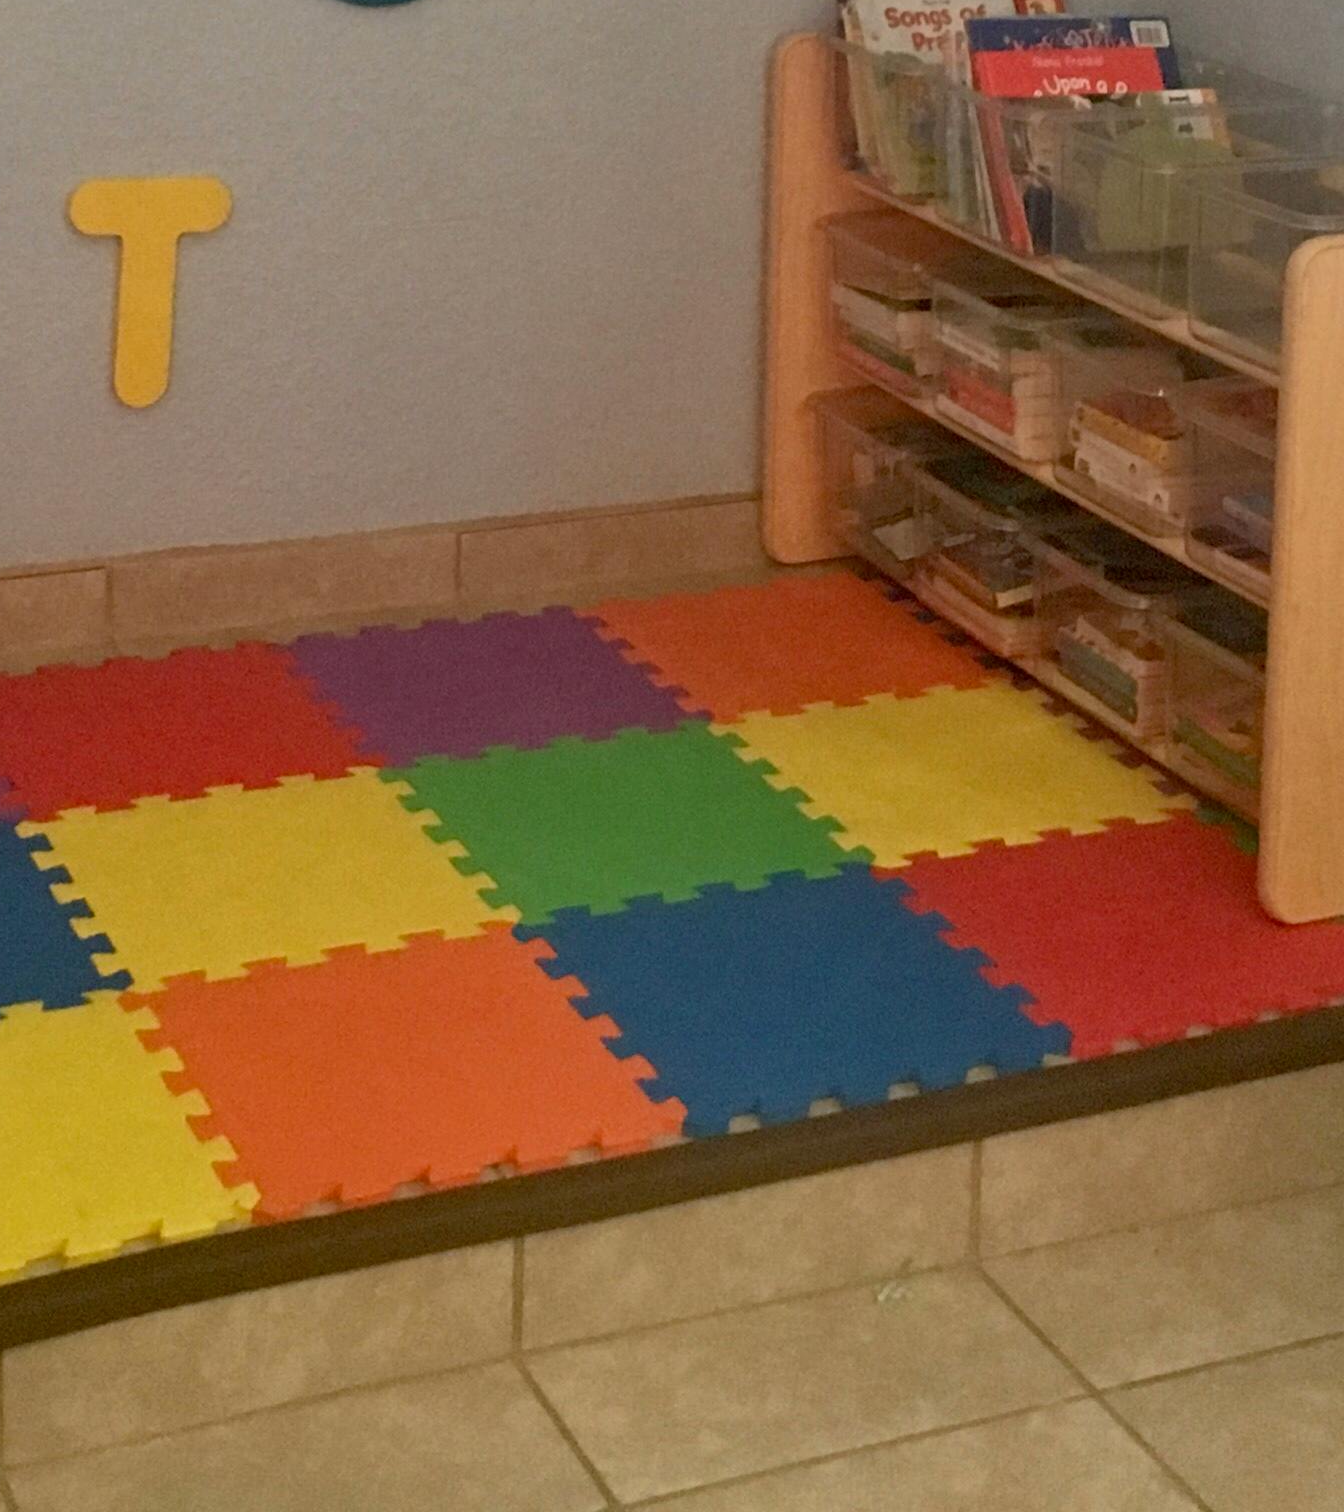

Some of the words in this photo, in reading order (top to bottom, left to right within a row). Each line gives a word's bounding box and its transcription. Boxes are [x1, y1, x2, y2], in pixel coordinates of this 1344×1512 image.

[884, 6, 953, 32] Songs
[1042, 74, 1092, 96] Upon
[69, 176, 230, 408] T
